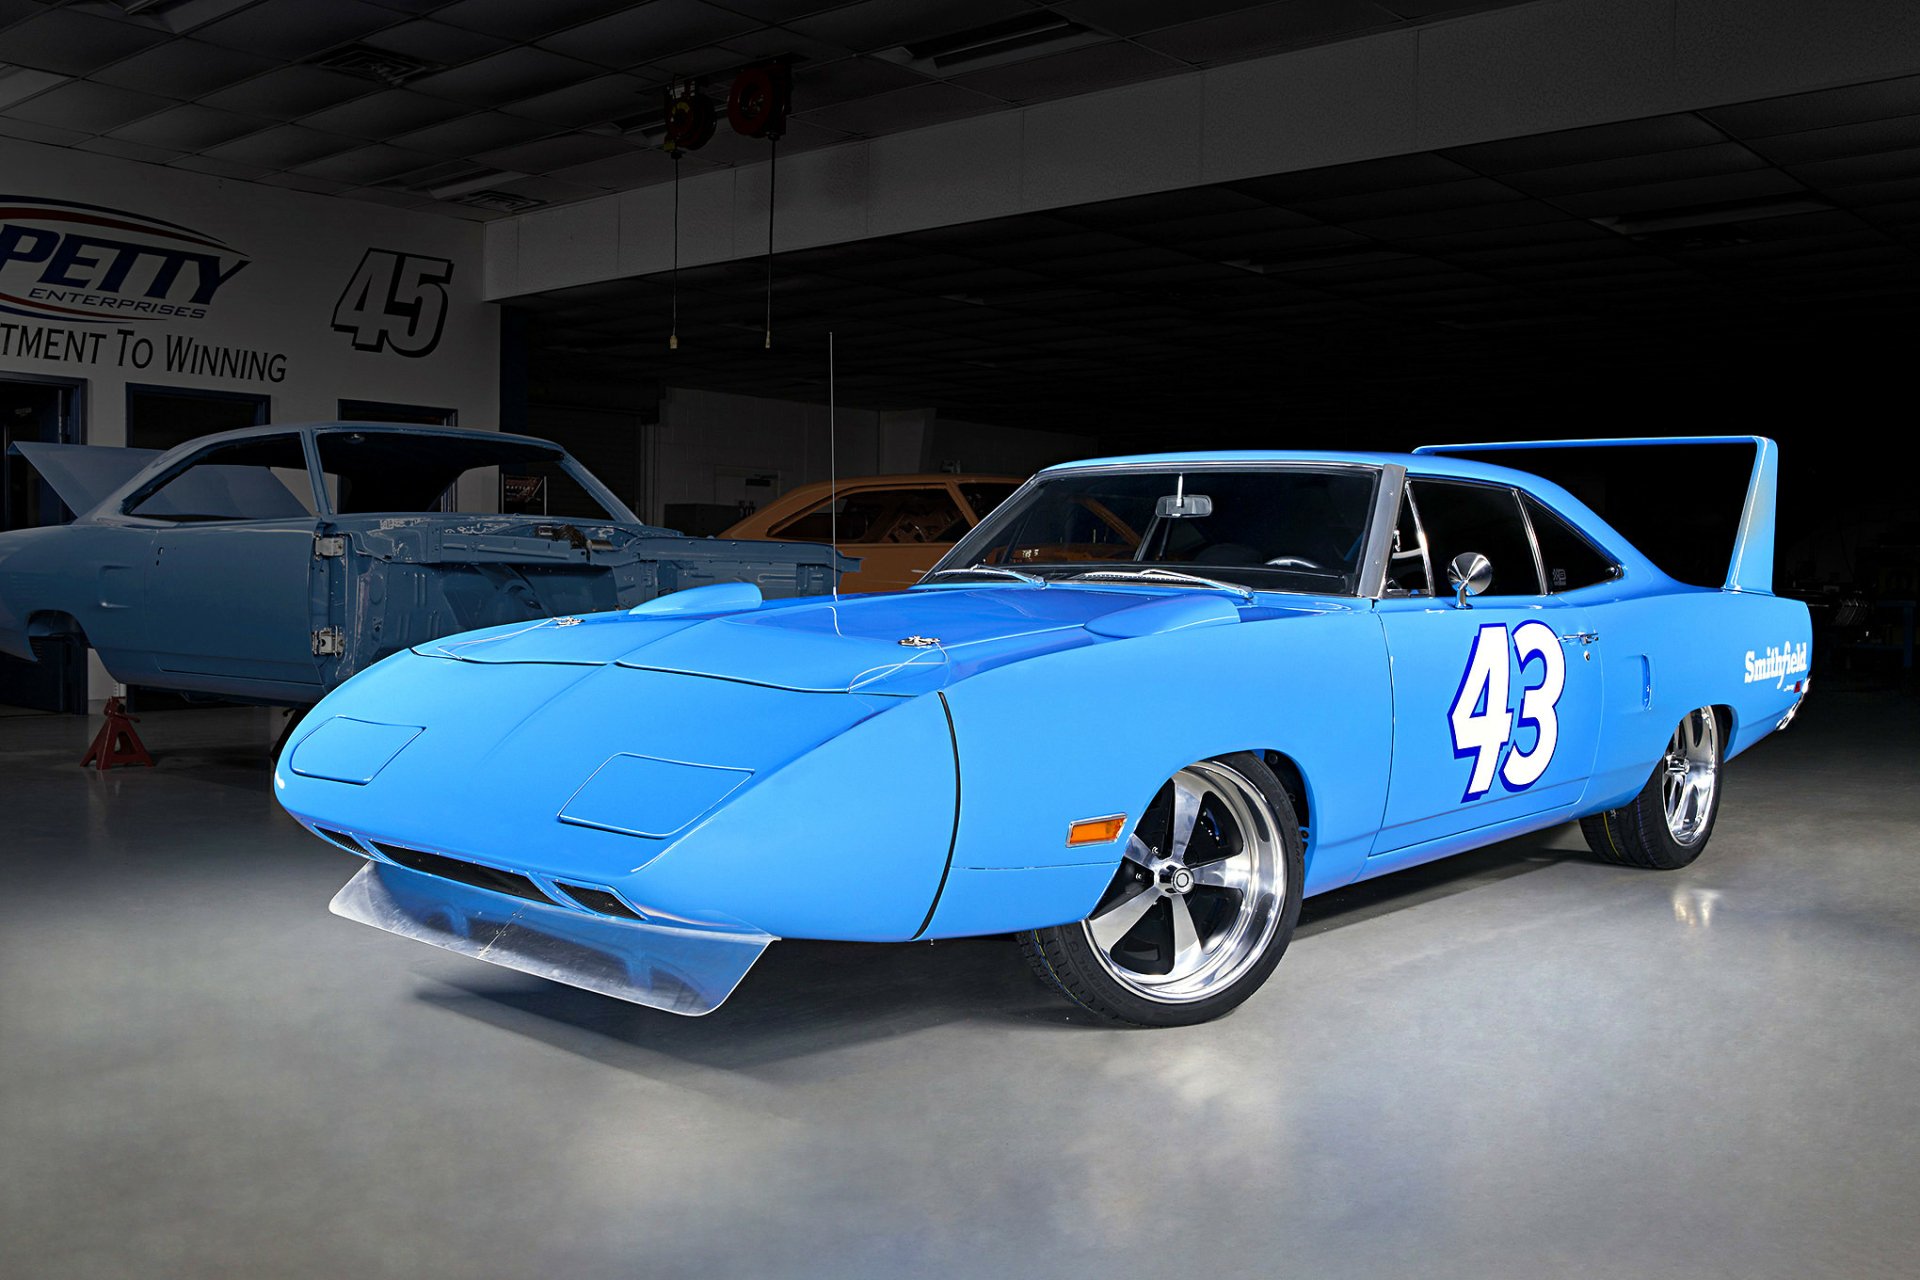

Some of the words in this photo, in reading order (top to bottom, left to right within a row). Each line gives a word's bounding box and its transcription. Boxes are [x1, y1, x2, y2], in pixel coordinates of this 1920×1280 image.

[0, 224, 251, 304] PETTY
[29, 288, 206, 319] ENTERPRISES
[331, 247, 454, 358] 45
[1744, 641, 1807, 690] Smithfield
[1447, 620, 1567, 803] 43
